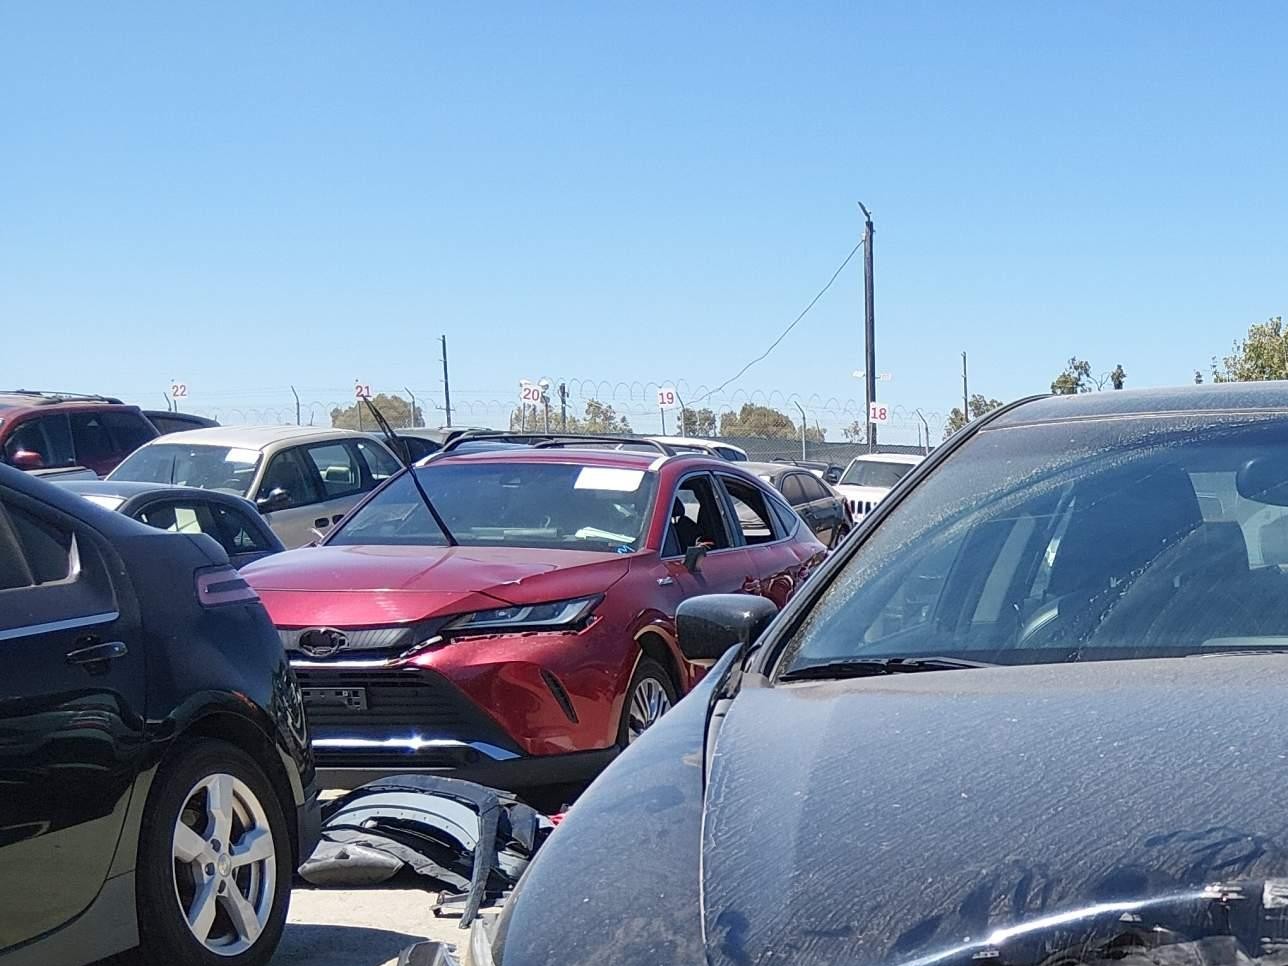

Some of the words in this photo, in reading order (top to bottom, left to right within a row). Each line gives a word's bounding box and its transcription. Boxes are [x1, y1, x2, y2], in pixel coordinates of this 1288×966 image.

[171, 384, 187, 397] 22
[355, 384, 373, 398] 21
[522, 387, 541, 402] 20
[658, 391, 675, 405] 19
[870, 406, 888, 421] 18
